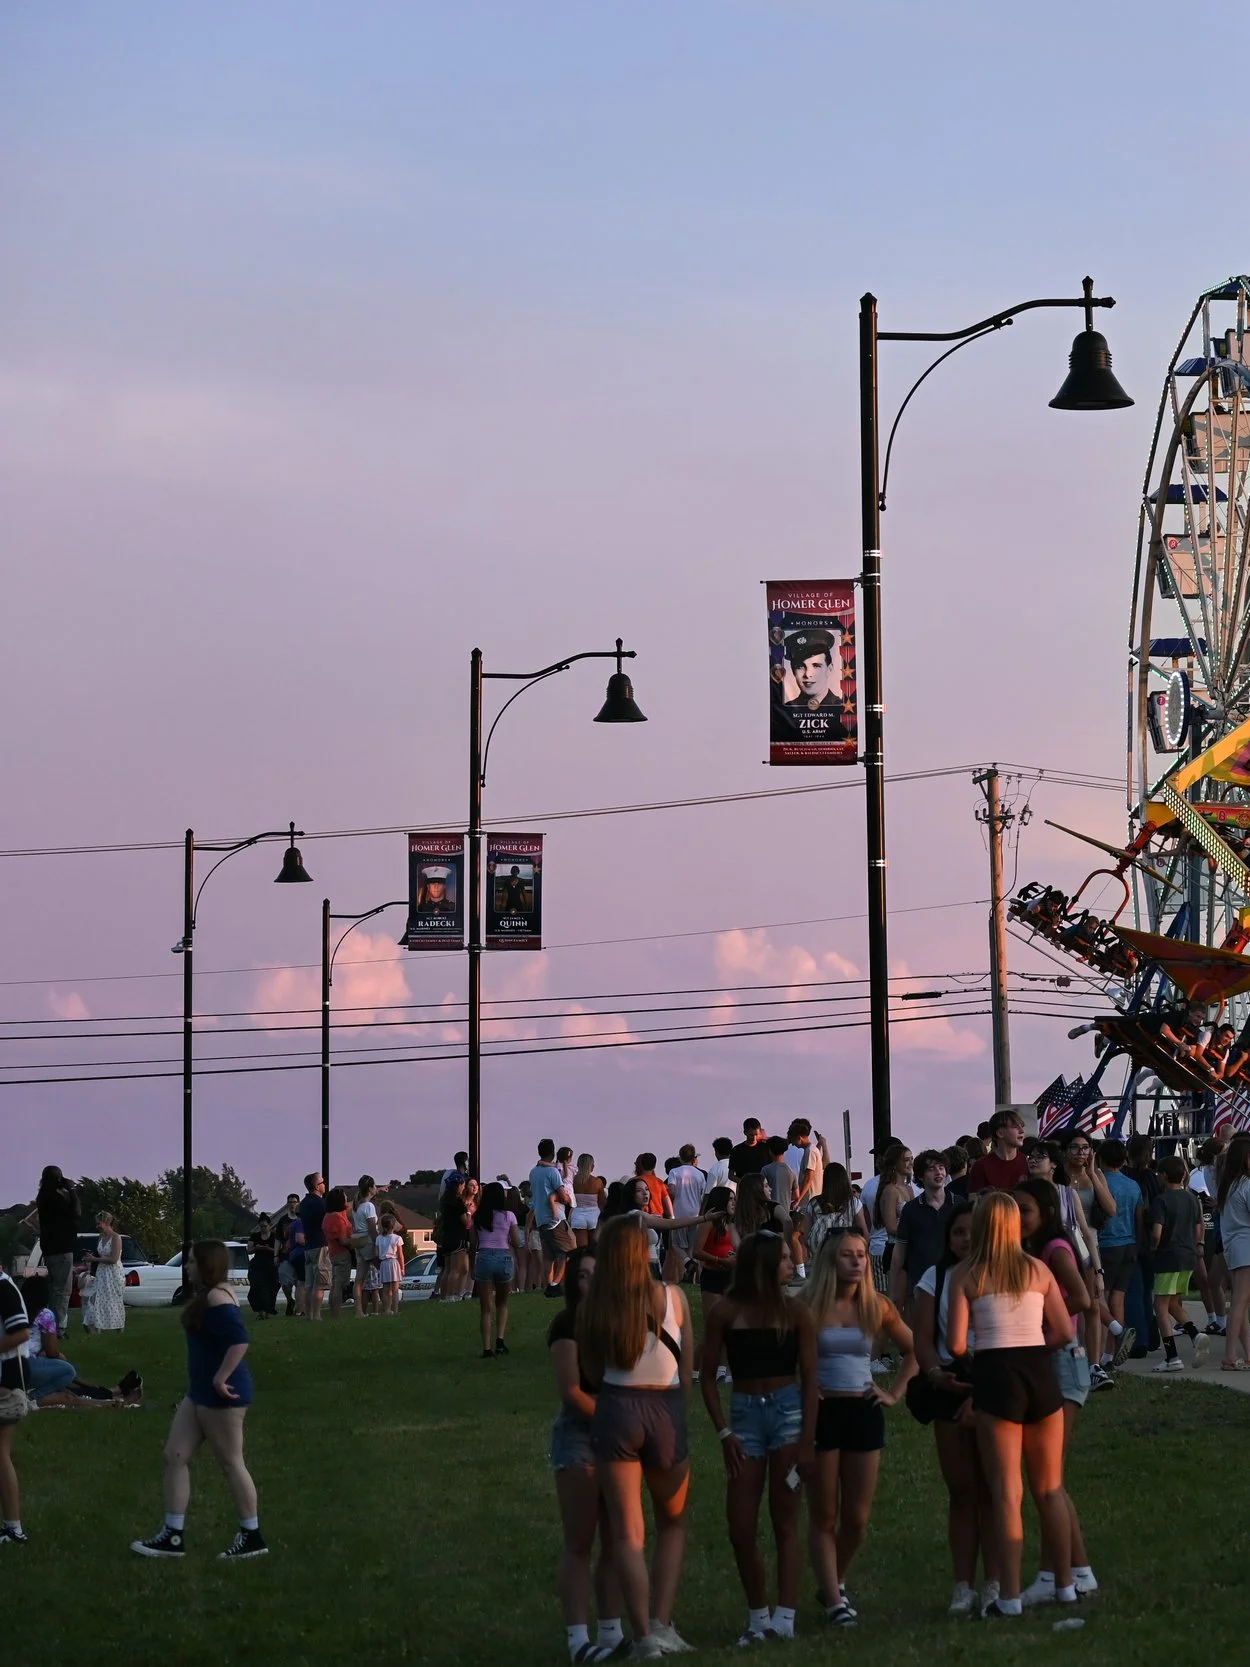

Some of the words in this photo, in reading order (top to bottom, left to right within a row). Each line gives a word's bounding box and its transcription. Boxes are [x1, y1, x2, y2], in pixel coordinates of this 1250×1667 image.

[772, 599, 816, 611] HOMER
[818, 598, 850, 610] GLEN
[799, 719, 829, 729] ZICK
[411, 844, 440, 852] HOMER
[441, 844, 462, 852] GLEN
[489, 844, 517, 852] HOMER
[519, 844, 540, 852] GLEN
[499, 920, 528, 929] QUINN
